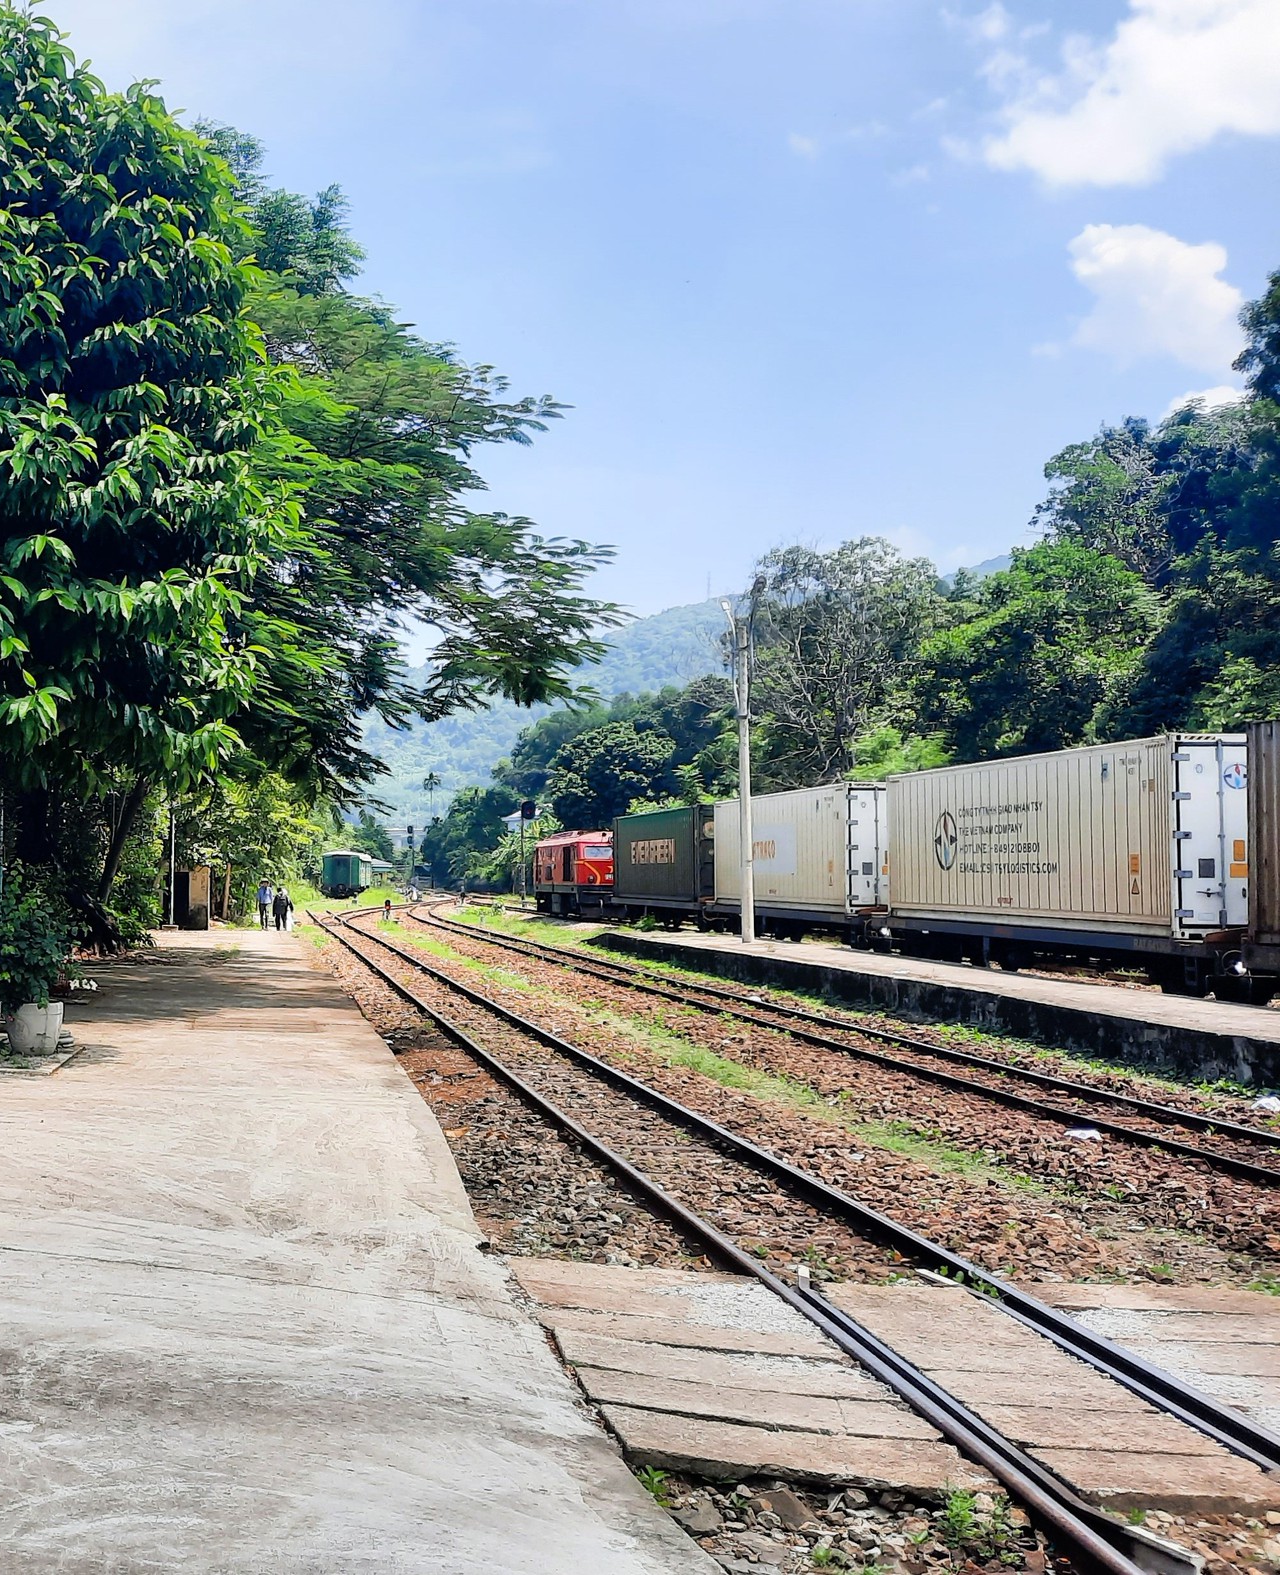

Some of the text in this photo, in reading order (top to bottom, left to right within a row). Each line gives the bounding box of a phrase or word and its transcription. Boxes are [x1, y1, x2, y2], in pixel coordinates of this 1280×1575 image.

[1030, 801, 1043, 812] TSY
[994, 822, 1023, 835] COMPANY
[630, 838, 675, 865] EVERGREEN
